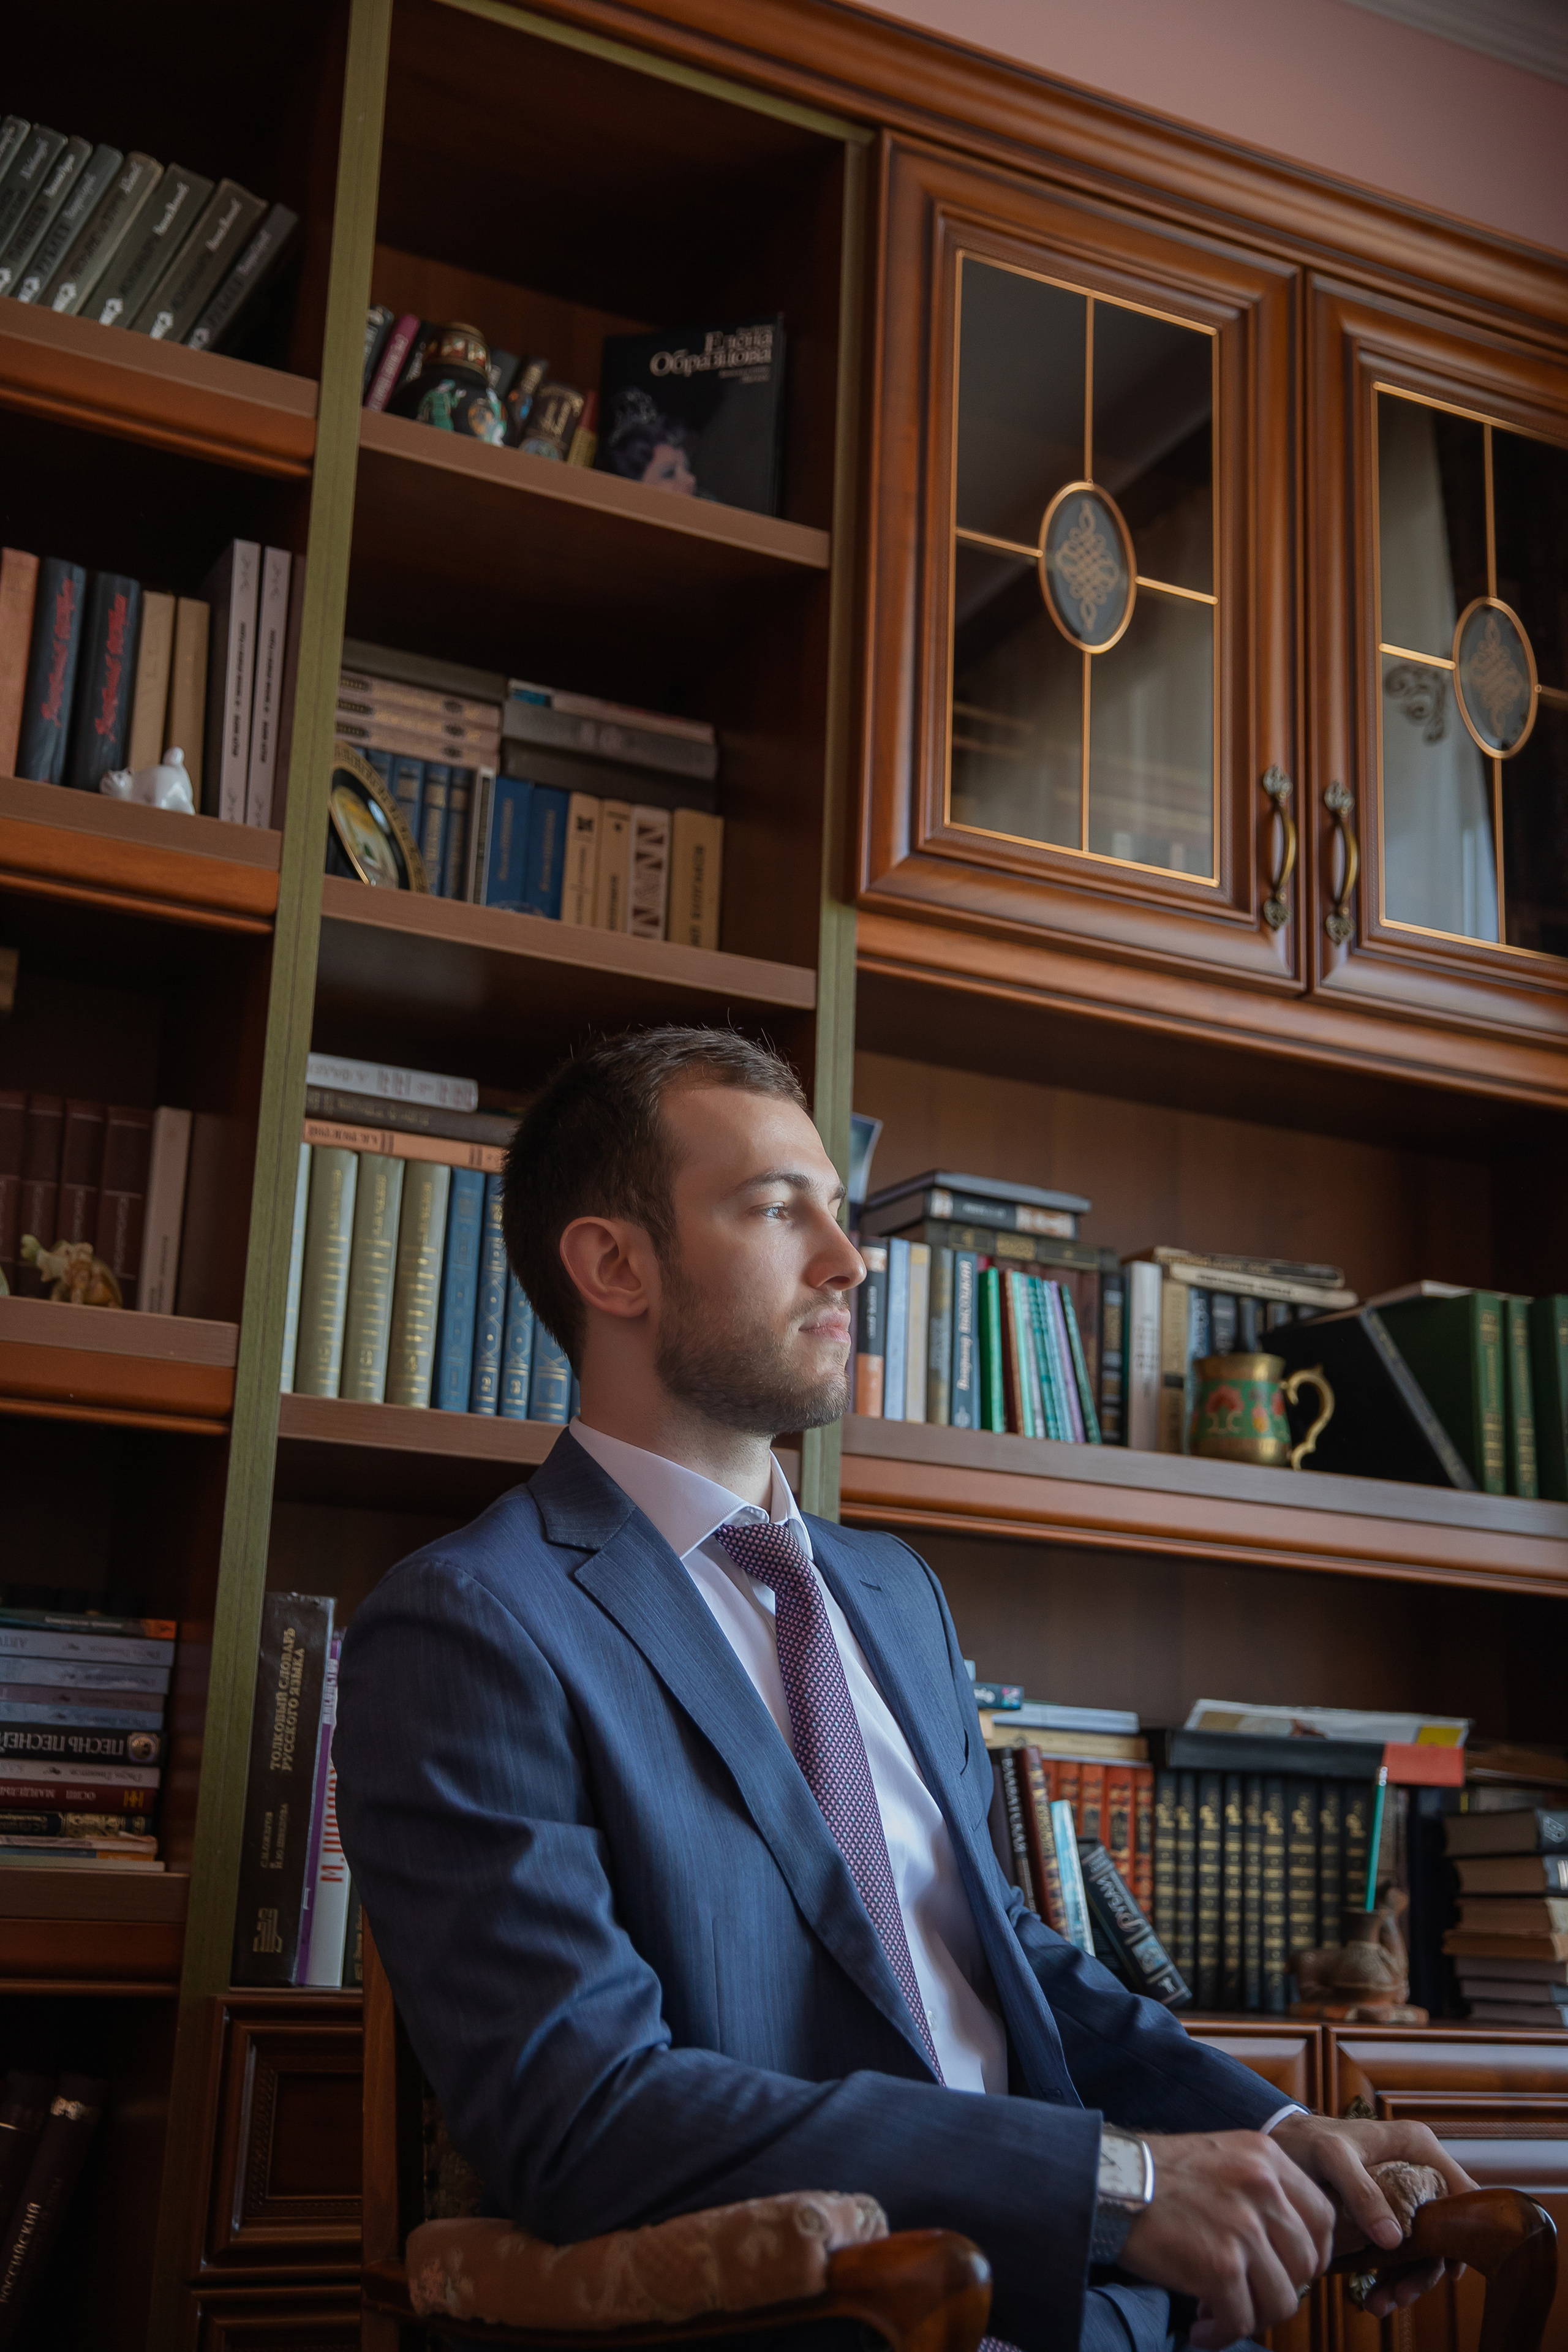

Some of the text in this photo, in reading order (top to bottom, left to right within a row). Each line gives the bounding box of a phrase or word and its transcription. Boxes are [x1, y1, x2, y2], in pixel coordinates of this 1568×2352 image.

[481, 1375, 492, 1392] 2
[510, 1379, 521, 1395] 3
[270, 1627, 296, 1770] ТОЛКОВЫЙ СЛОВАРЬ
[282, 1648, 305, 1771] РУССКОГО ЯЗЫКА
[68, 1736, 124, 1756] ПЕСНЬ
